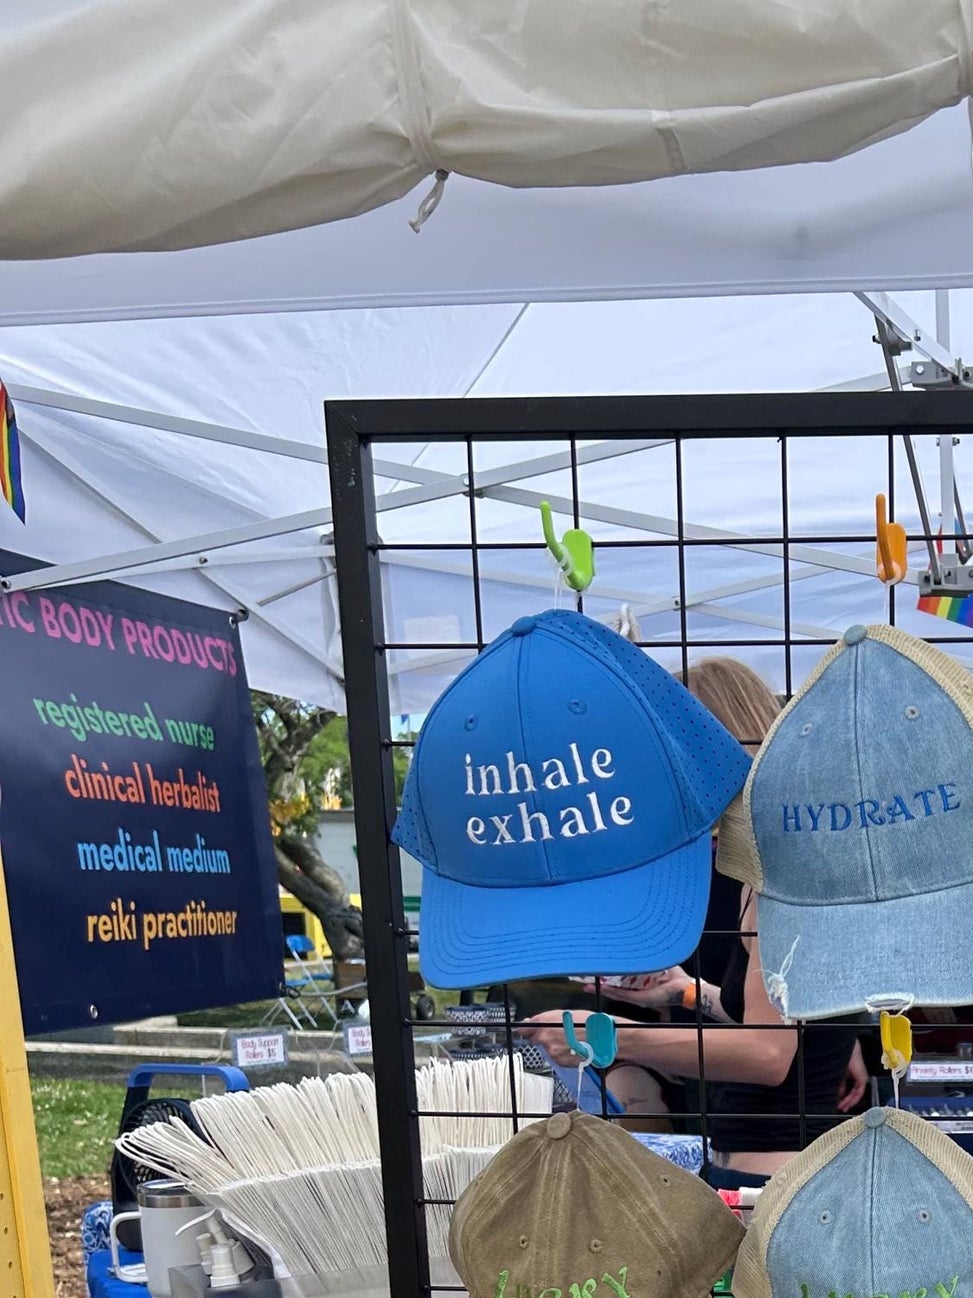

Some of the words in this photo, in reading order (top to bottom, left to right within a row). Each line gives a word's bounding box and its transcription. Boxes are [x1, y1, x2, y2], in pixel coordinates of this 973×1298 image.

[0, 591, 36, 633] IC
[40, 597, 115, 650] BODY
[122, 616, 237, 677] PRODUCTS
[33, 693, 163, 742] registered
[165, 718, 215, 750] nurse
[65, 754, 146, 804] clinical
[145, 763, 221, 812] herbalist
[464, 742, 616, 796] inhale
[466, 791, 635, 845] exhale
[782, 782, 961, 832] HYDRATE
[77, 827, 163, 872] medical
[167, 833, 231, 874] medium
[87, 897, 137, 942] reiki
[143, 900, 238, 950] practitioner
